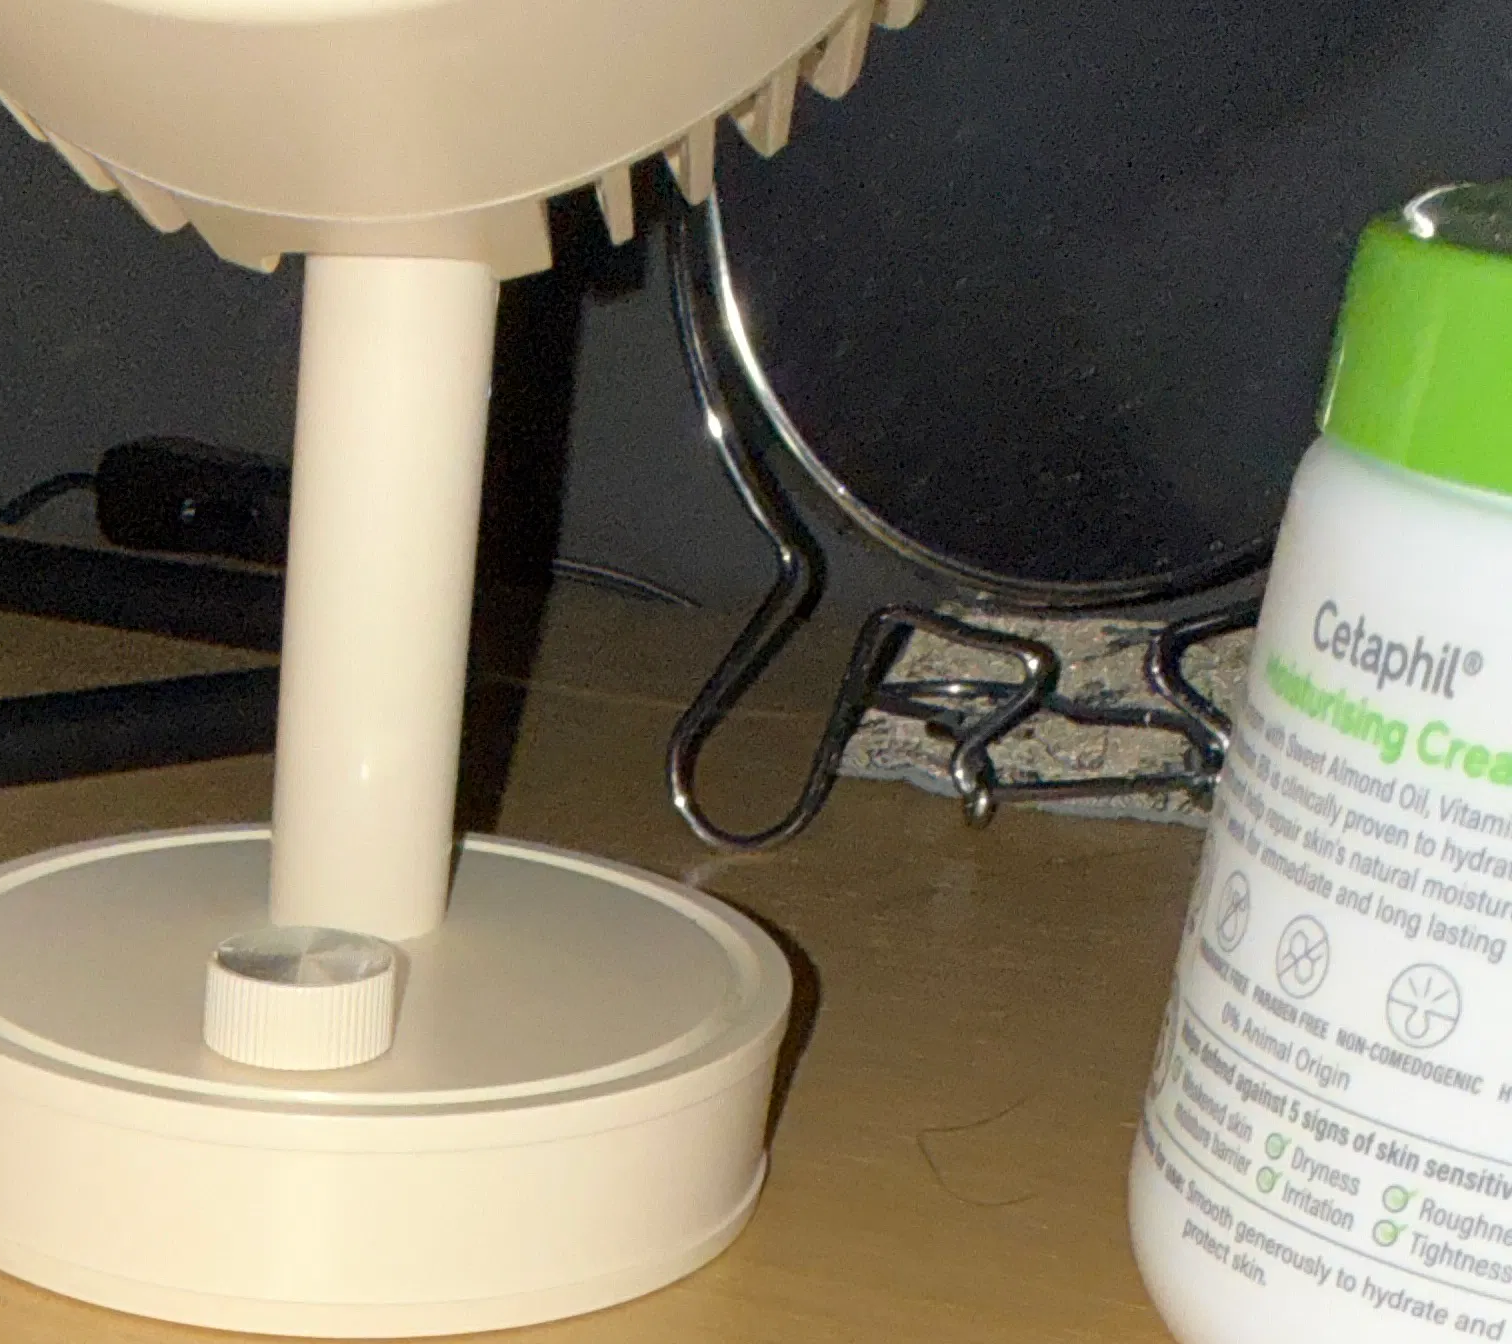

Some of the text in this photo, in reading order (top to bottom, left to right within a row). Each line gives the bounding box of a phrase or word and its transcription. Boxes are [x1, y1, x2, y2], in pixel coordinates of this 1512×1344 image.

[1281, 774, 1343, 828] clinically
[1342, 807, 1409, 850] proven
[1414, 829, 1436, 858] to
[1327, 754, 1397, 804] Almond
[1398, 782, 1430, 820] Oil,
[1265, 806, 1302, 843] repair
[1301, 827, 1347, 866] skin's
[1348, 848, 1421, 893] natural
[1422, 875, 1512, 922] moistur
[1260, 847, 1333, 900] immediate
[1335, 884, 1374, 917] and
[1375, 894, 1423, 940] long
[1426, 911, 1507, 965] lasting
[1241, 1016, 1294, 1063] Animal
[1295, 1046, 1351, 1091] Origin
[1299, 1010, 1330, 1040] FREE
[1336, 1027, 1484, 1096] NON-COMEDOGENIC
[1212, 1132, 1252, 1176] barrier
[1226, 1110, 1252, 1142] skin
[1235, 1072, 1287, 1118] against
[1288, 1099, 1301, 1124] 5
[1301, 1105, 1350, 1147] signs
[1352, 1131, 1376, 1156] of
[1375, 1139, 1420, 1173] skin
[1281, 1179, 1355, 1232] Irritation
[1291, 1146, 1361, 1197] Dryness
[1182, 1217, 1267, 1287] protect skin.
[1186, 1179, 1234, 1231] Smooth
[1235, 1219, 1332, 1286] generously
[1335, 1266, 1357, 1293] to
[1361, 1275, 1449, 1326] hydrate
[1454, 1313, 1507, 1342] and
